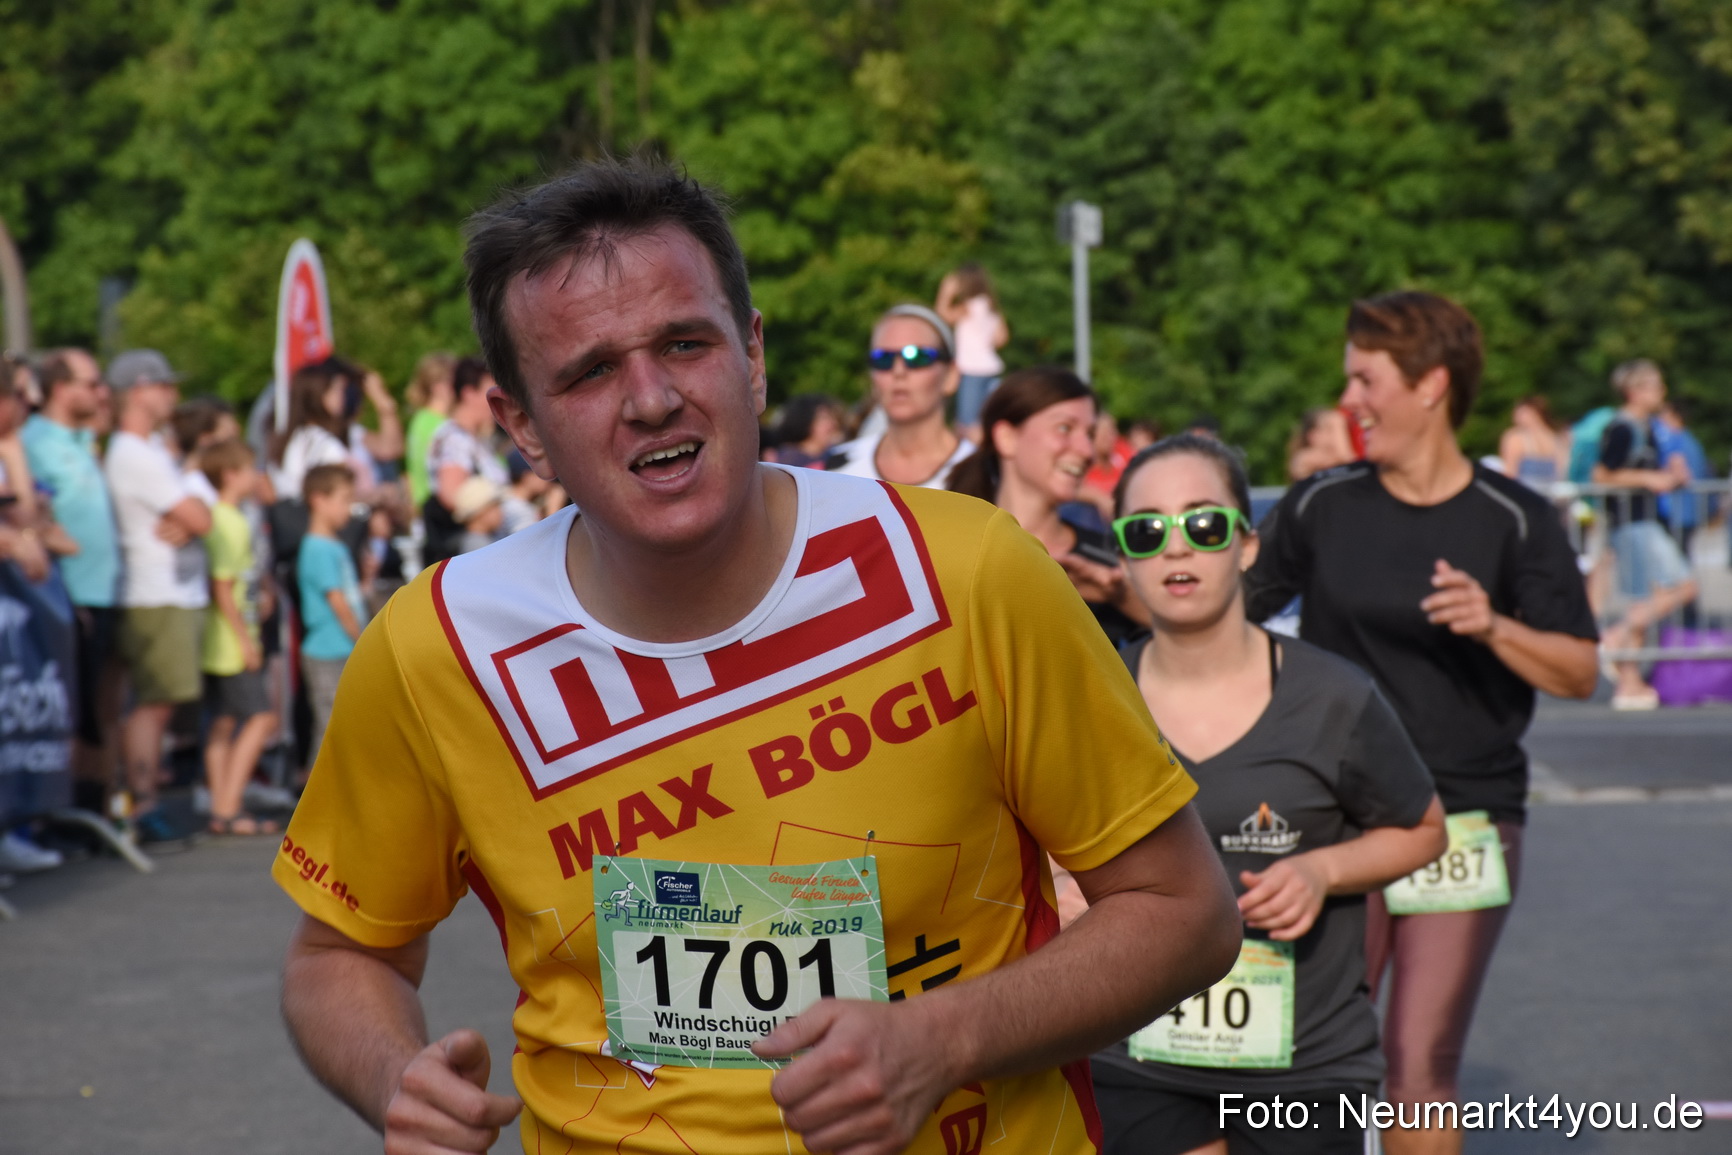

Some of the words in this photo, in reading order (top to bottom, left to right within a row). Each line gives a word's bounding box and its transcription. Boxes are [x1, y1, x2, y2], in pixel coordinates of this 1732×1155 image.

[548, 763, 735, 880] MAX
[748, 667, 977, 799] BÖGL
[663, 881, 693, 890] Fischer
[769, 871, 818, 886] Gesunde
[821, 875, 861, 887] Firmen
[791, 887, 827, 902] laufen
[830, 889, 872, 907] länger!
[638, 900, 743, 924] firmenlauf
[638, 920, 684, 929] neumarkt
[769, 921, 803, 937] run
[811, 916, 863, 936] 2019
[636, 935, 836, 1011] 1701
[654, 1011, 778, 1037] Windschügl
[649, 1032, 676, 1046] Max
[680, 1034, 711, 1050] Bögl
